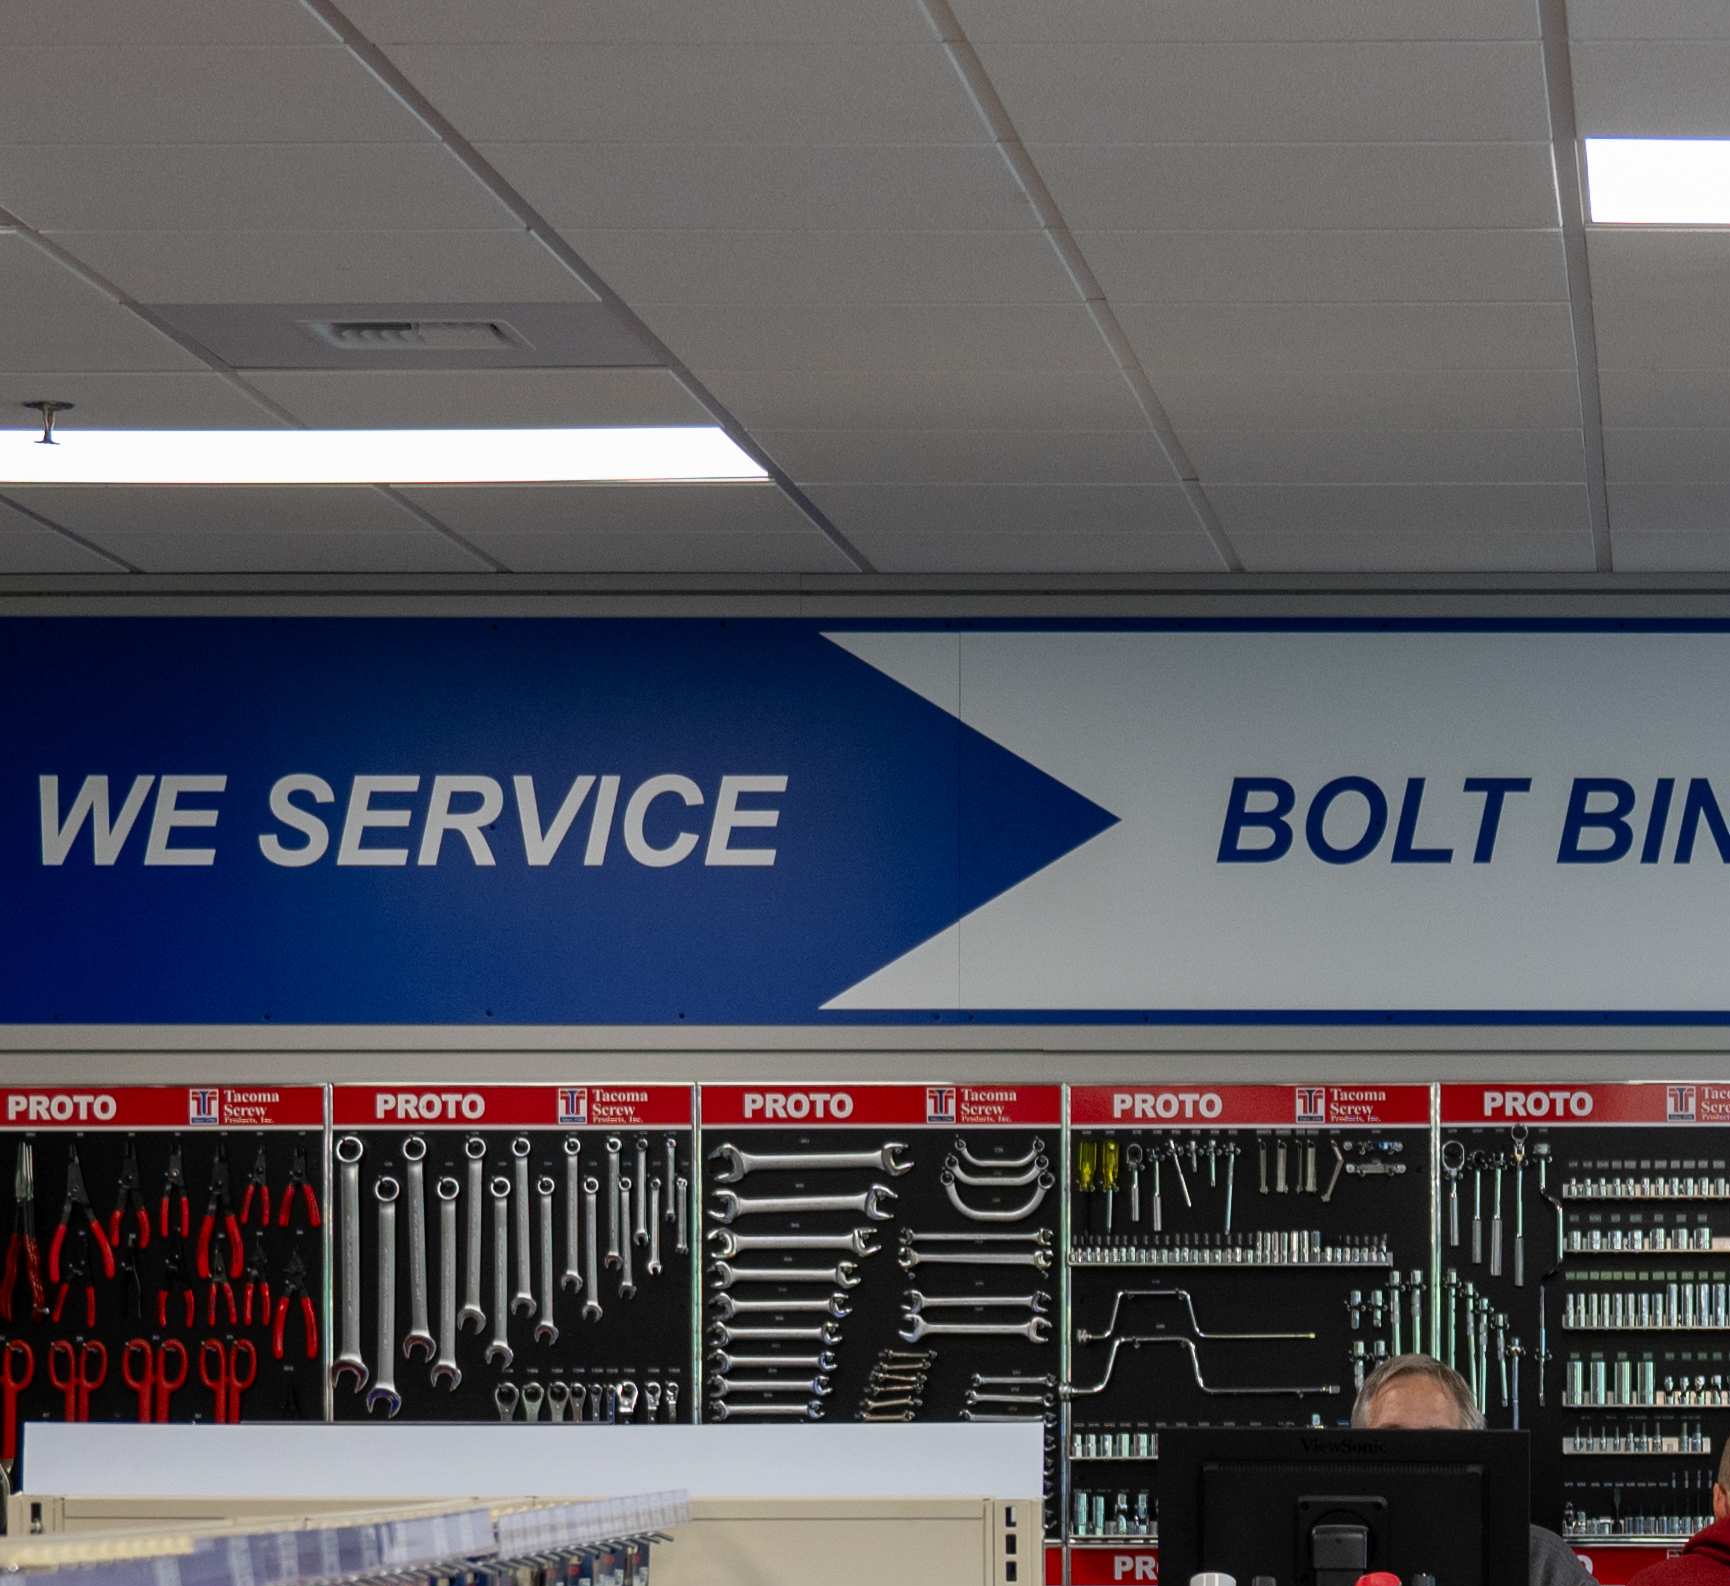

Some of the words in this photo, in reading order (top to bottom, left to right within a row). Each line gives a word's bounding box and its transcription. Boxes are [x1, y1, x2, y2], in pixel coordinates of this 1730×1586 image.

[38, 774, 228, 867] WE
[258, 773, 790, 868] SERVICE
[1216, 775, 1533, 866] BOLT
[223, 1089, 280, 1103] Tacoma
[592, 1088, 649, 1102] Tacoma
[961, 1087, 1018, 1101] Tacoma
[1330, 1087, 1387, 1101] Tacoma
[7, 1094, 118, 1121] PROTO
[223, 1103, 267, 1116] Screw
[375, 1092, 486, 1119] PROTO
[592, 1102, 636, 1115] Screw
[743, 1092, 855, 1119] PROTO
[961, 1101, 1005, 1114] Screw
[1112, 1092, 1224, 1119] PROTO
[1330, 1101, 1374, 1114] Screw
[1482, 1090, 1594, 1117] PROTO
[1301, 1441, 1387, 1460] ViewSonic
